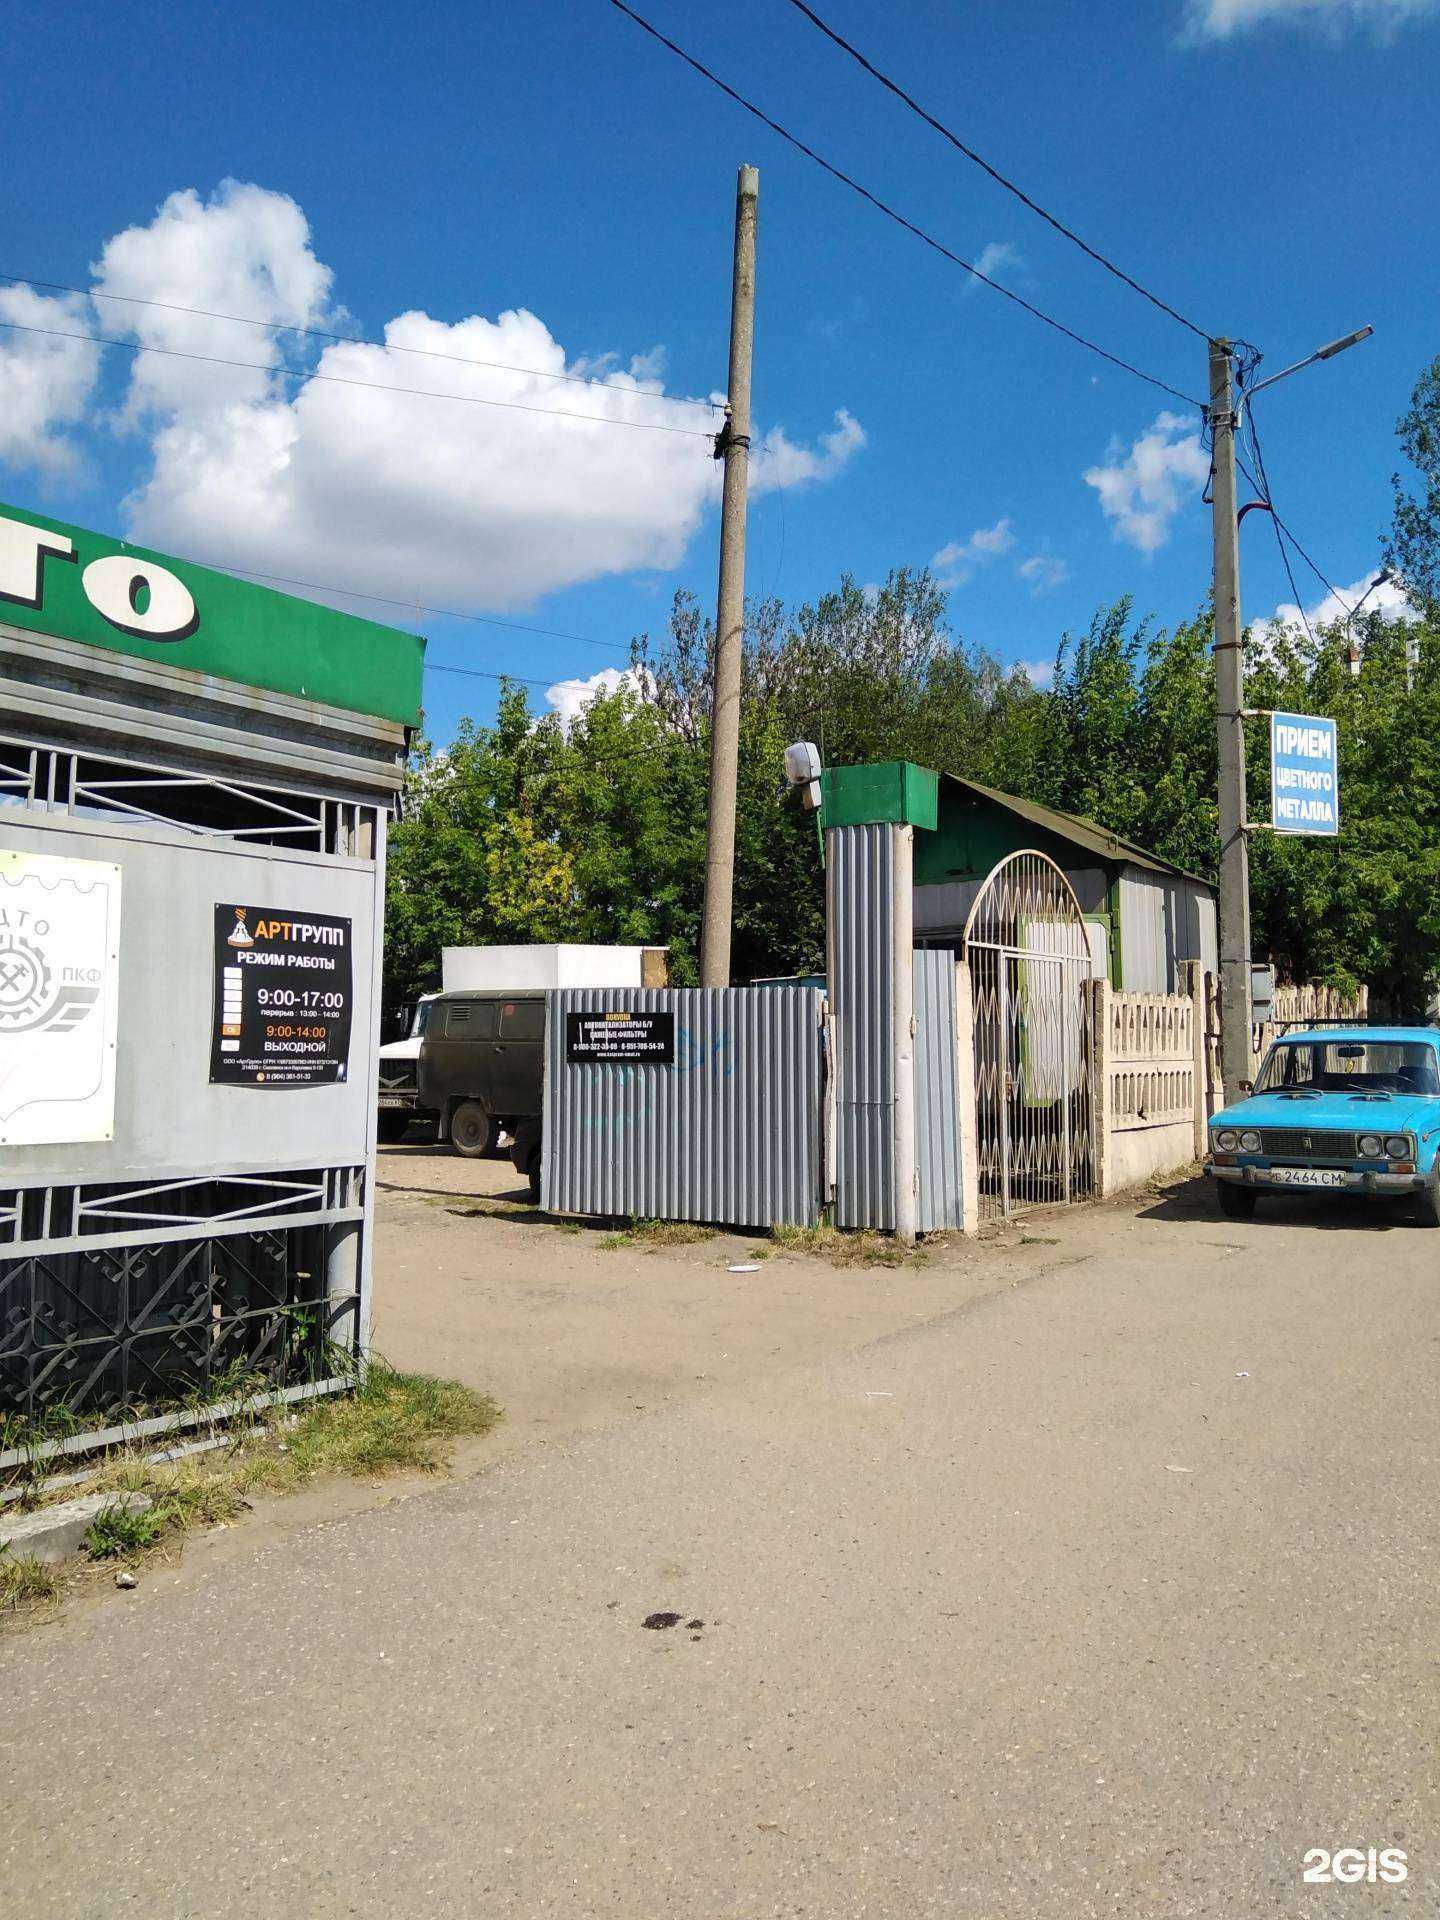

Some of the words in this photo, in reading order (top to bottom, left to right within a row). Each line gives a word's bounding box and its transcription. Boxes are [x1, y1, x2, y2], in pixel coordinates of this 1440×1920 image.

[1276, 725, 1331, 759] ПРИЕМ
[1276, 766, 1332, 792] ЦВЕТНОГО
[1277, 797, 1334, 822] МЕТАЛЛА
[254, 920, 343, 946] АРТГРУПП
[237, 951, 284, 966] РЕЖИМ
[288, 955, 334, 969] РАБОТЫ
[62, 967, 102, 982] ПКФ
[257, 988, 343, 1008] 9:00-17:00
[260, 1009, 294, 1018] перерыв
[266, 1025, 326, 1038] 9:00-14:00
[264, 1041, 326, 1052] ВЫХОДНОЙ
[1285, 1171, 1318, 1184] 2464
